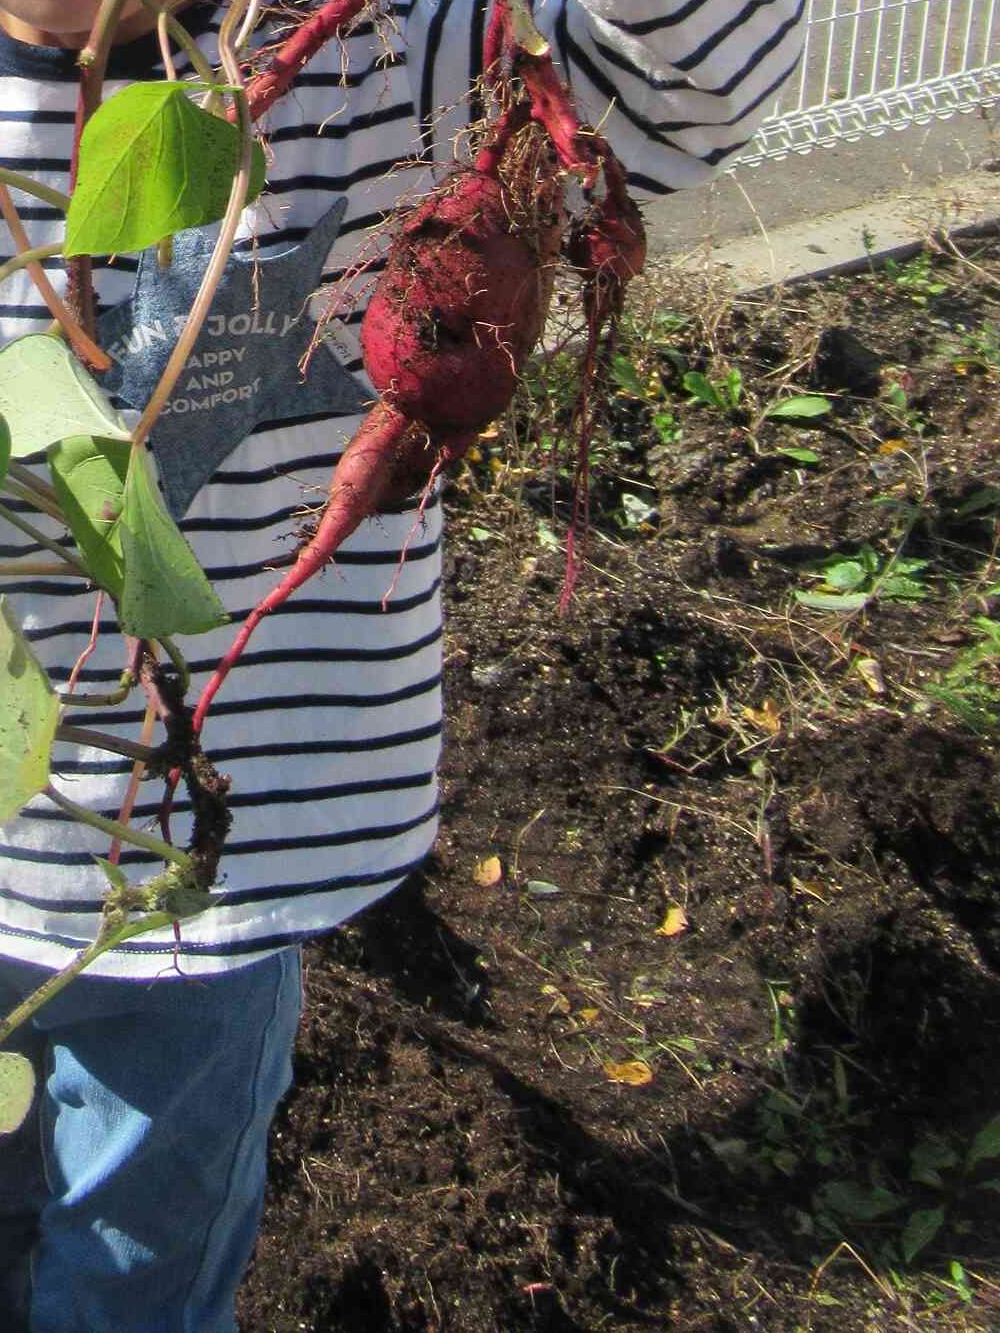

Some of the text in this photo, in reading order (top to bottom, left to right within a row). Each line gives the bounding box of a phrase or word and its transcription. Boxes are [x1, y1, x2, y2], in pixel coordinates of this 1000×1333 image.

[207, 311, 298, 338] JOLLY
[185, 346, 247, 369] APPY
[185, 371, 235, 392] AND
